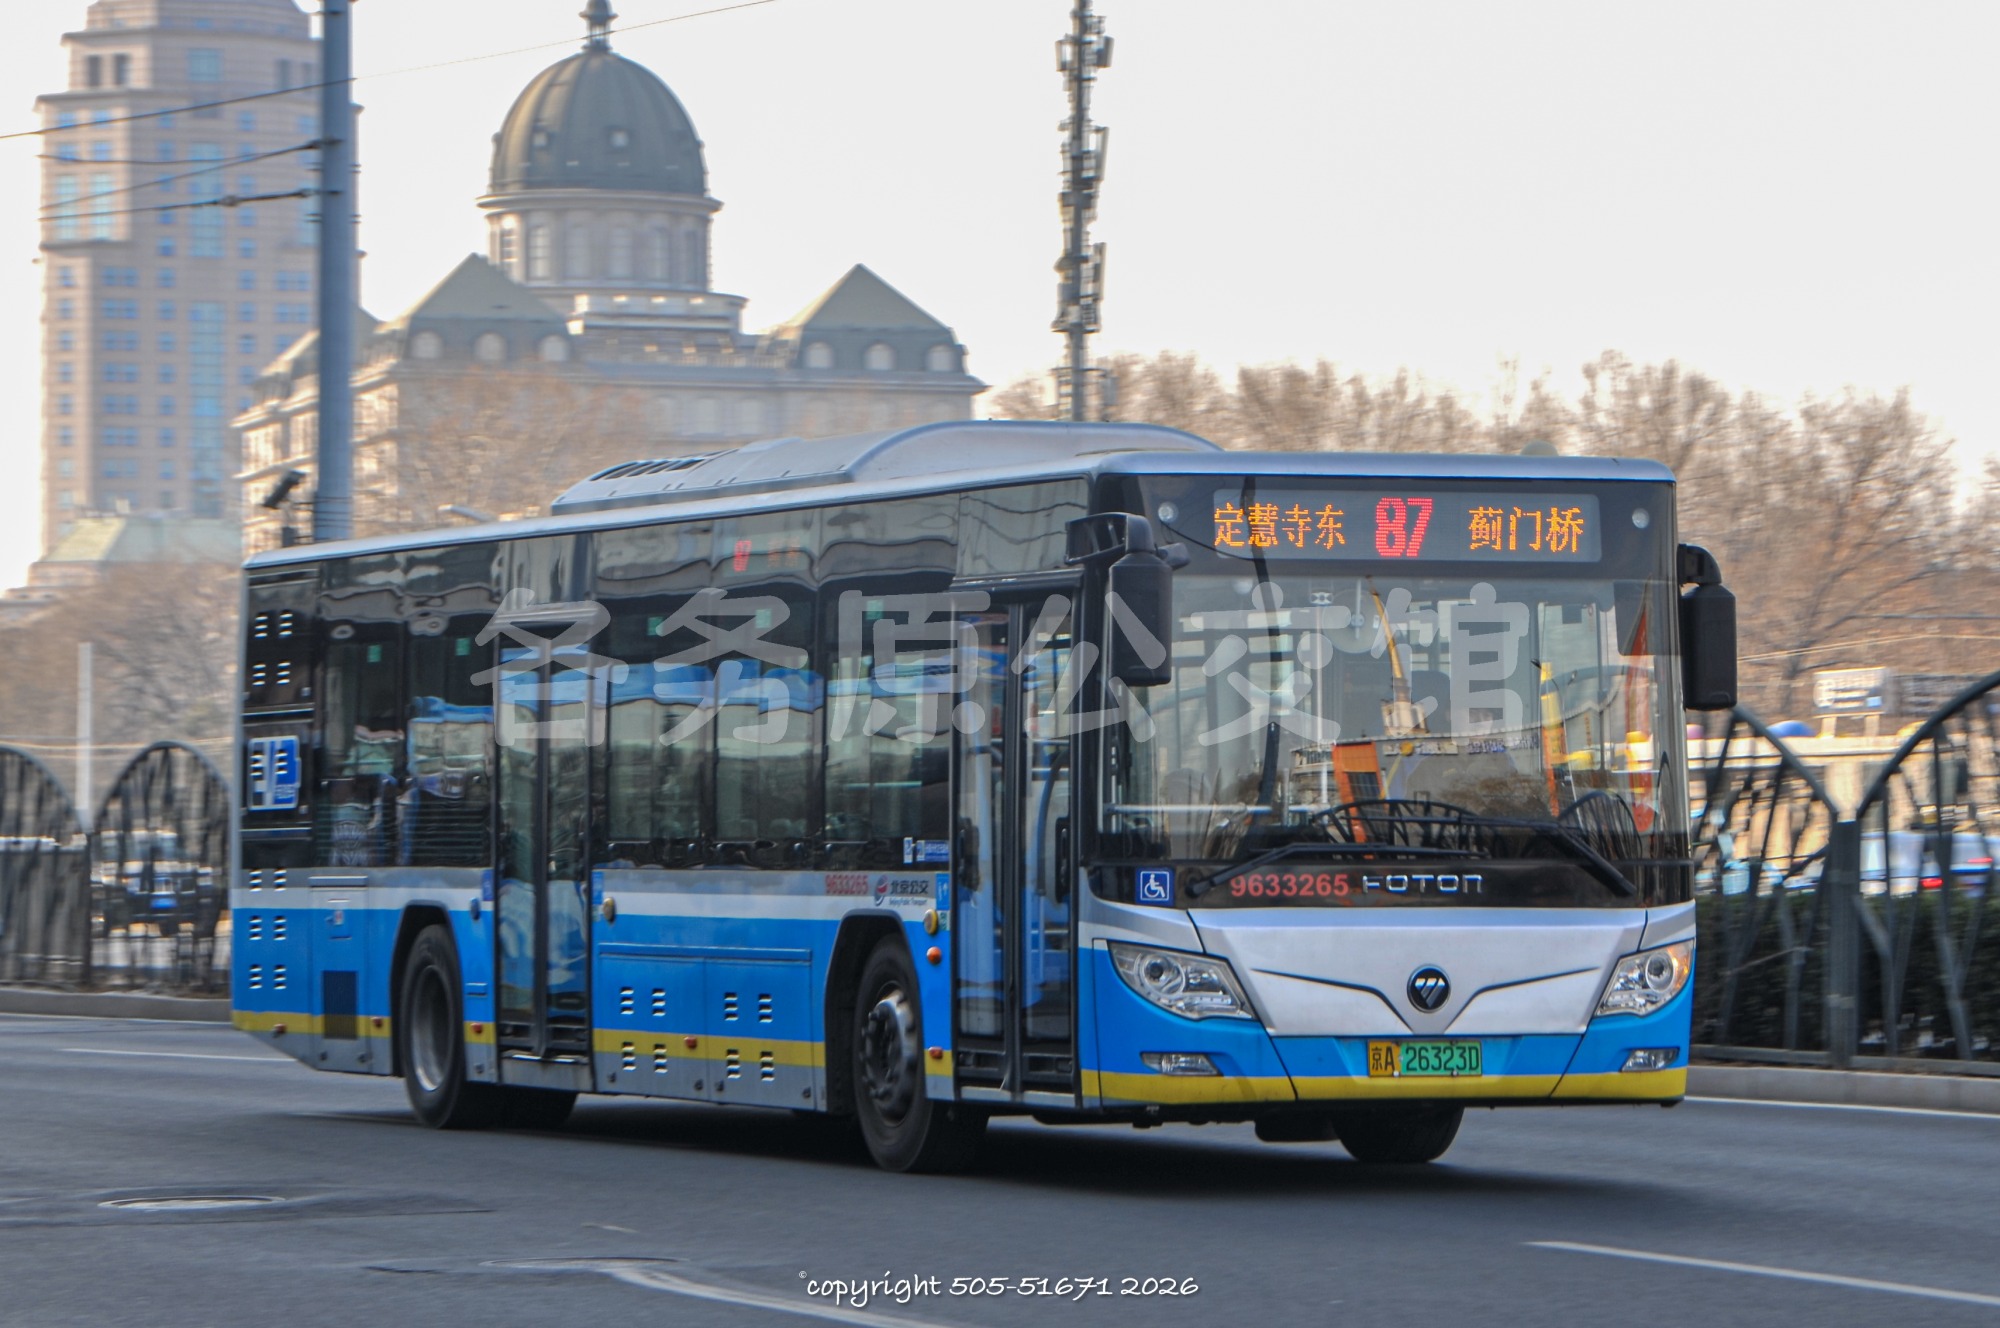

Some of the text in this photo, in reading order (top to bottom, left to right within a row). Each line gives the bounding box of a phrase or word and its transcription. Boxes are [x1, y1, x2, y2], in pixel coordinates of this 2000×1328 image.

[1213, 497, 1584, 558] 定慧寺东 87 蓟门桥
[890, 879, 929, 895] 北京公交
[1230, 873, 1349, 897] 9633265
[1362, 874, 1483, 893] FOTON
